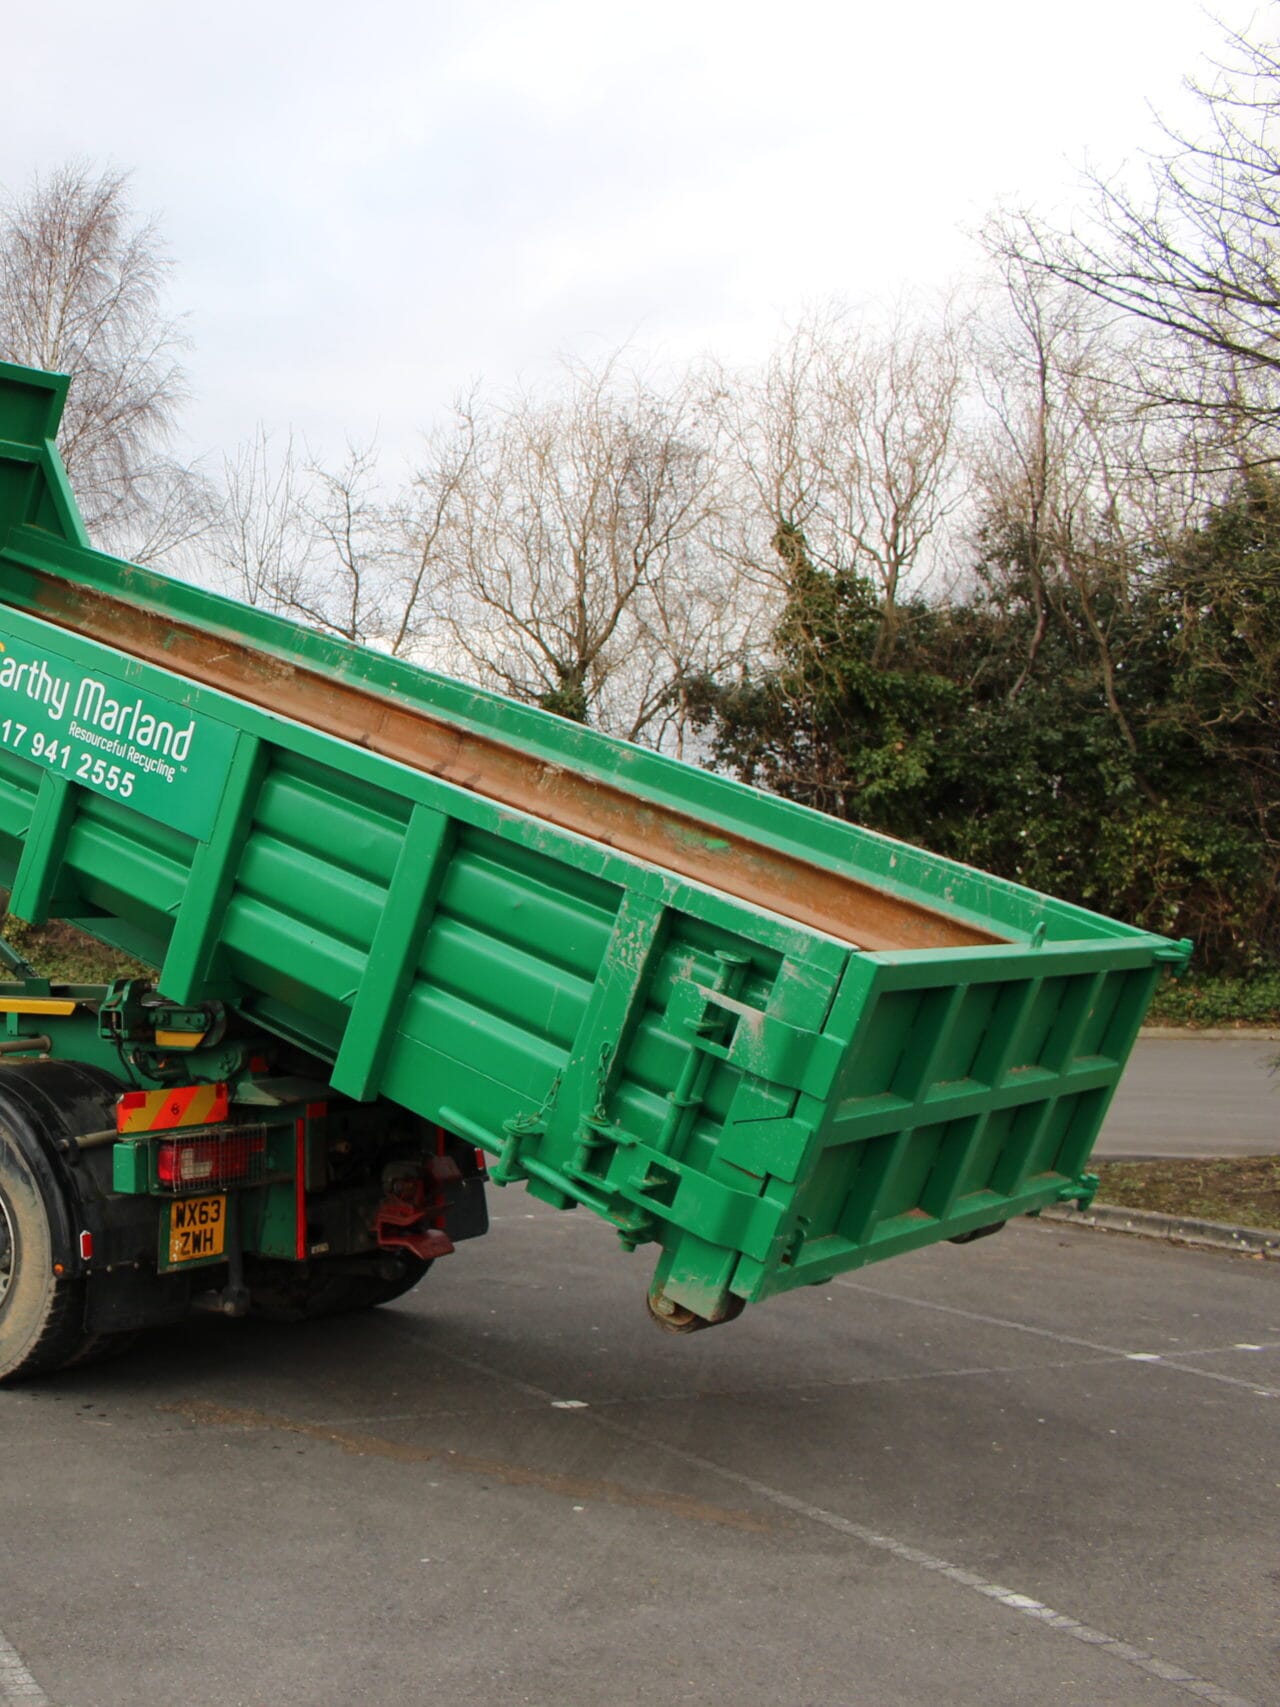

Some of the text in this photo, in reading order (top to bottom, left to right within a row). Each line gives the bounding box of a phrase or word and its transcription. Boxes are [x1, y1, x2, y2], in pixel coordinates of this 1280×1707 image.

[73, 678, 195, 762] Marland
[31, 732, 71, 770] 941
[76, 753, 136, 797] 2555
[68, 721, 128, 759] Resourceful
[126, 745, 176, 783] Recycling
[175, 1199, 221, 1229] WX63
[180, 1227, 214, 1256] ZWH
